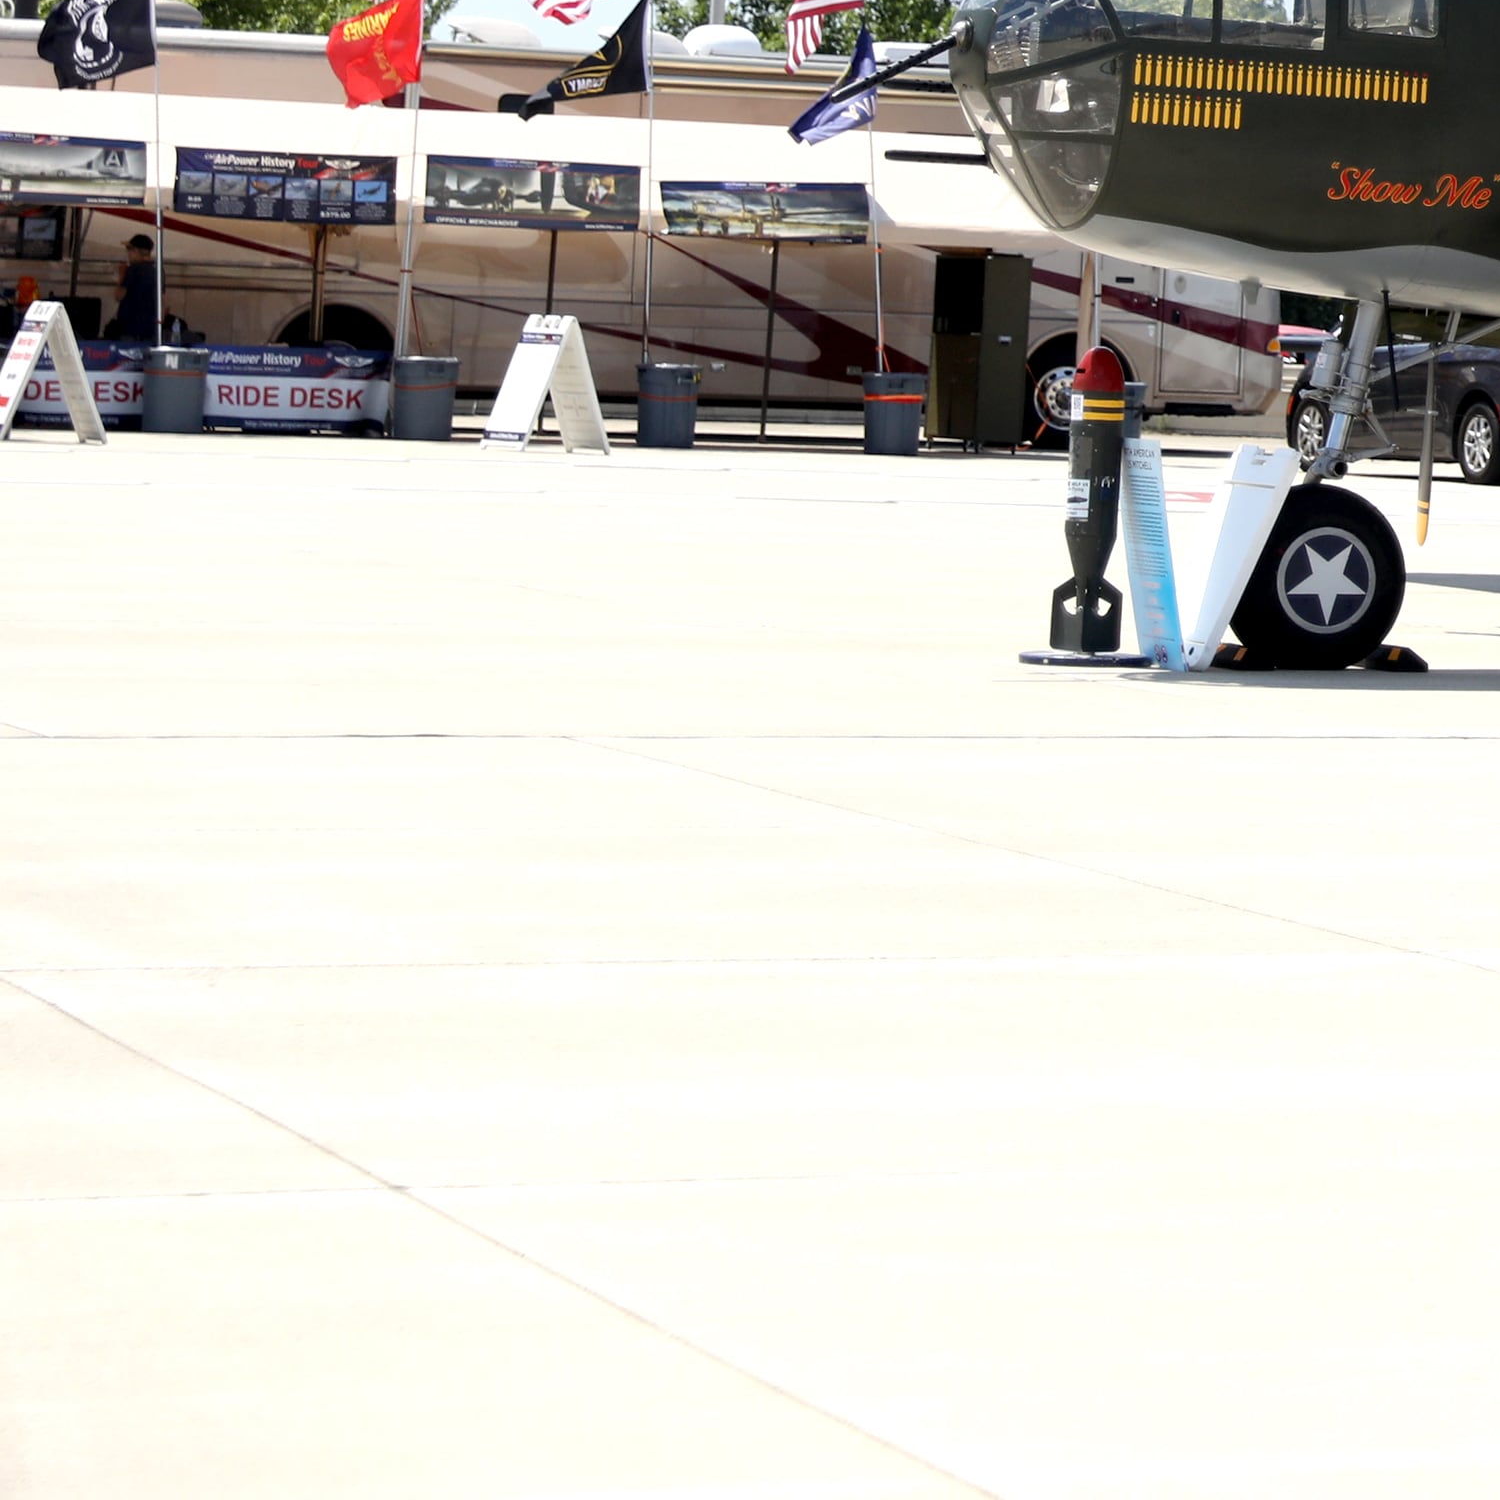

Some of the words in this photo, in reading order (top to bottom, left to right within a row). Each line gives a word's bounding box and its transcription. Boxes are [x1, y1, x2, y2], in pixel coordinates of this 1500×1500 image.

[214, 154, 259, 167] AirPower
[261, 156, 295, 171] History
[210, 352, 260, 366] AirPower
[263, 353, 301, 368] History
[218, 384, 280, 408] RIDE
[290, 387, 364, 410] DESK
